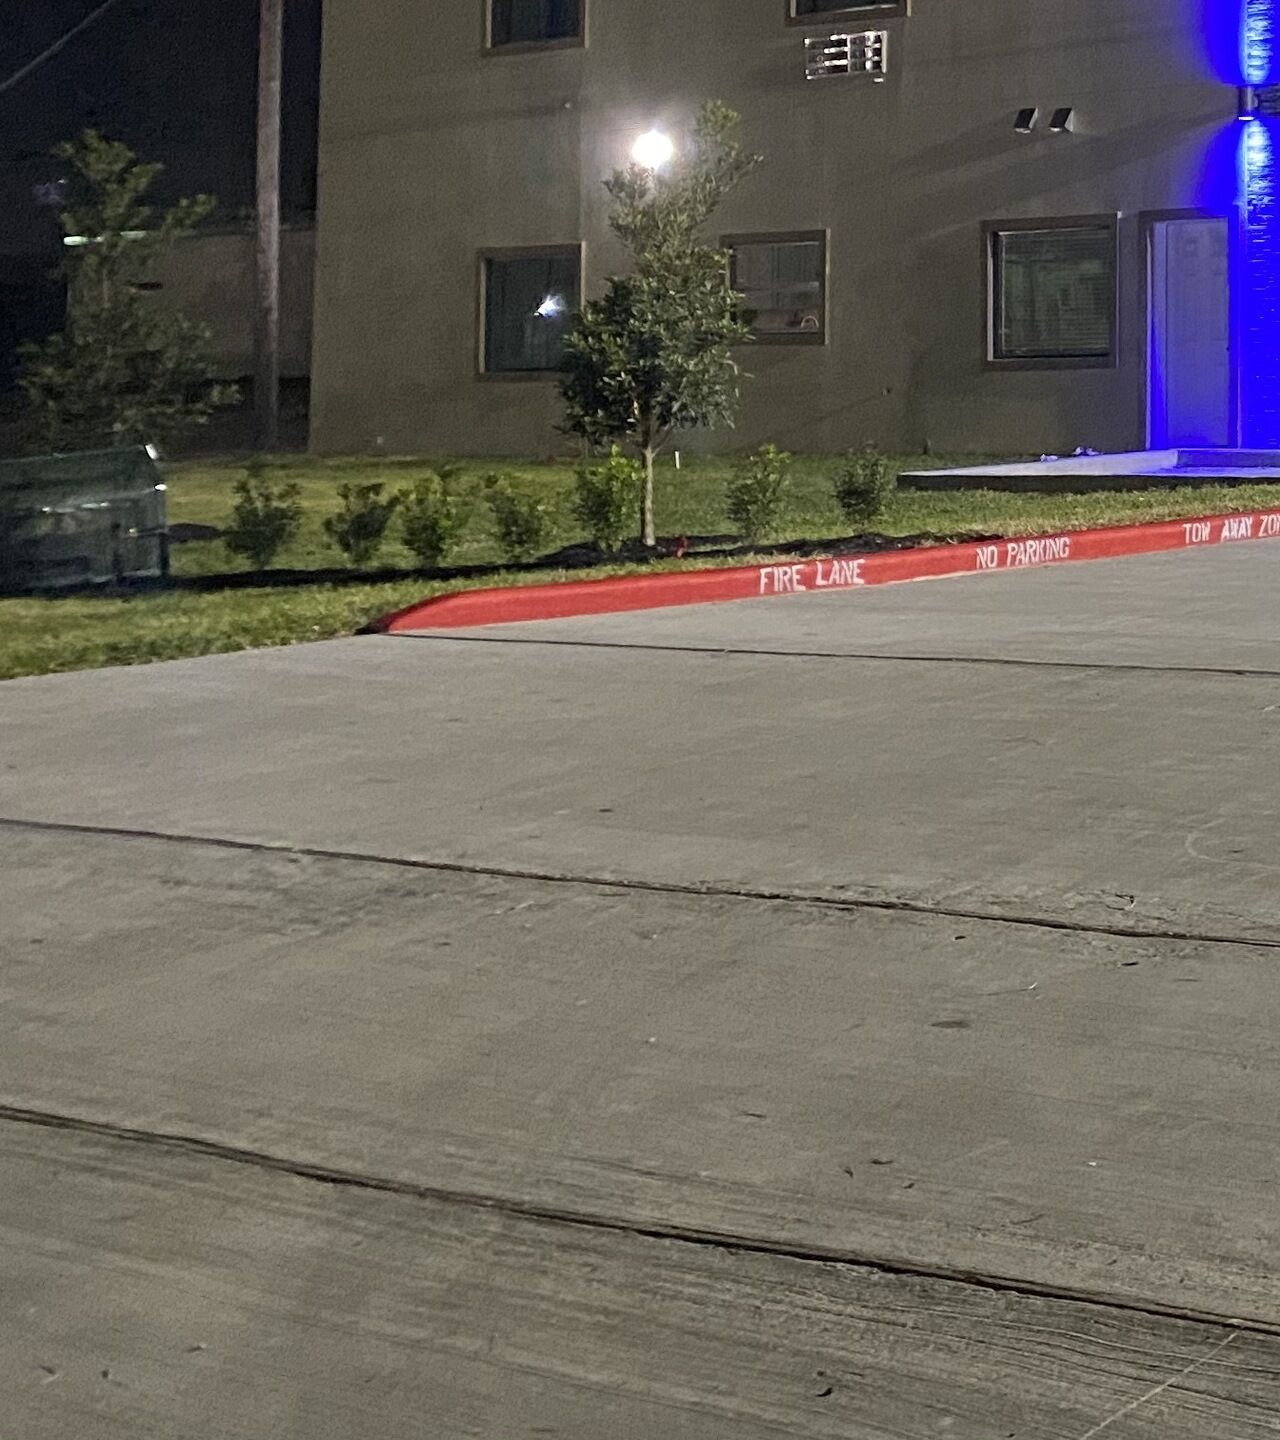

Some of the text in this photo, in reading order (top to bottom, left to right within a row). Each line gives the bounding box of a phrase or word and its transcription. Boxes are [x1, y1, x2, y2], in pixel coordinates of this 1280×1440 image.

[1182, 521, 1211, 544] TOW
[1220, 516, 1253, 542] AWAY
[976, 537, 1070, 569] NO PARKING
[760, 559, 866, 594] FIRE LANE
